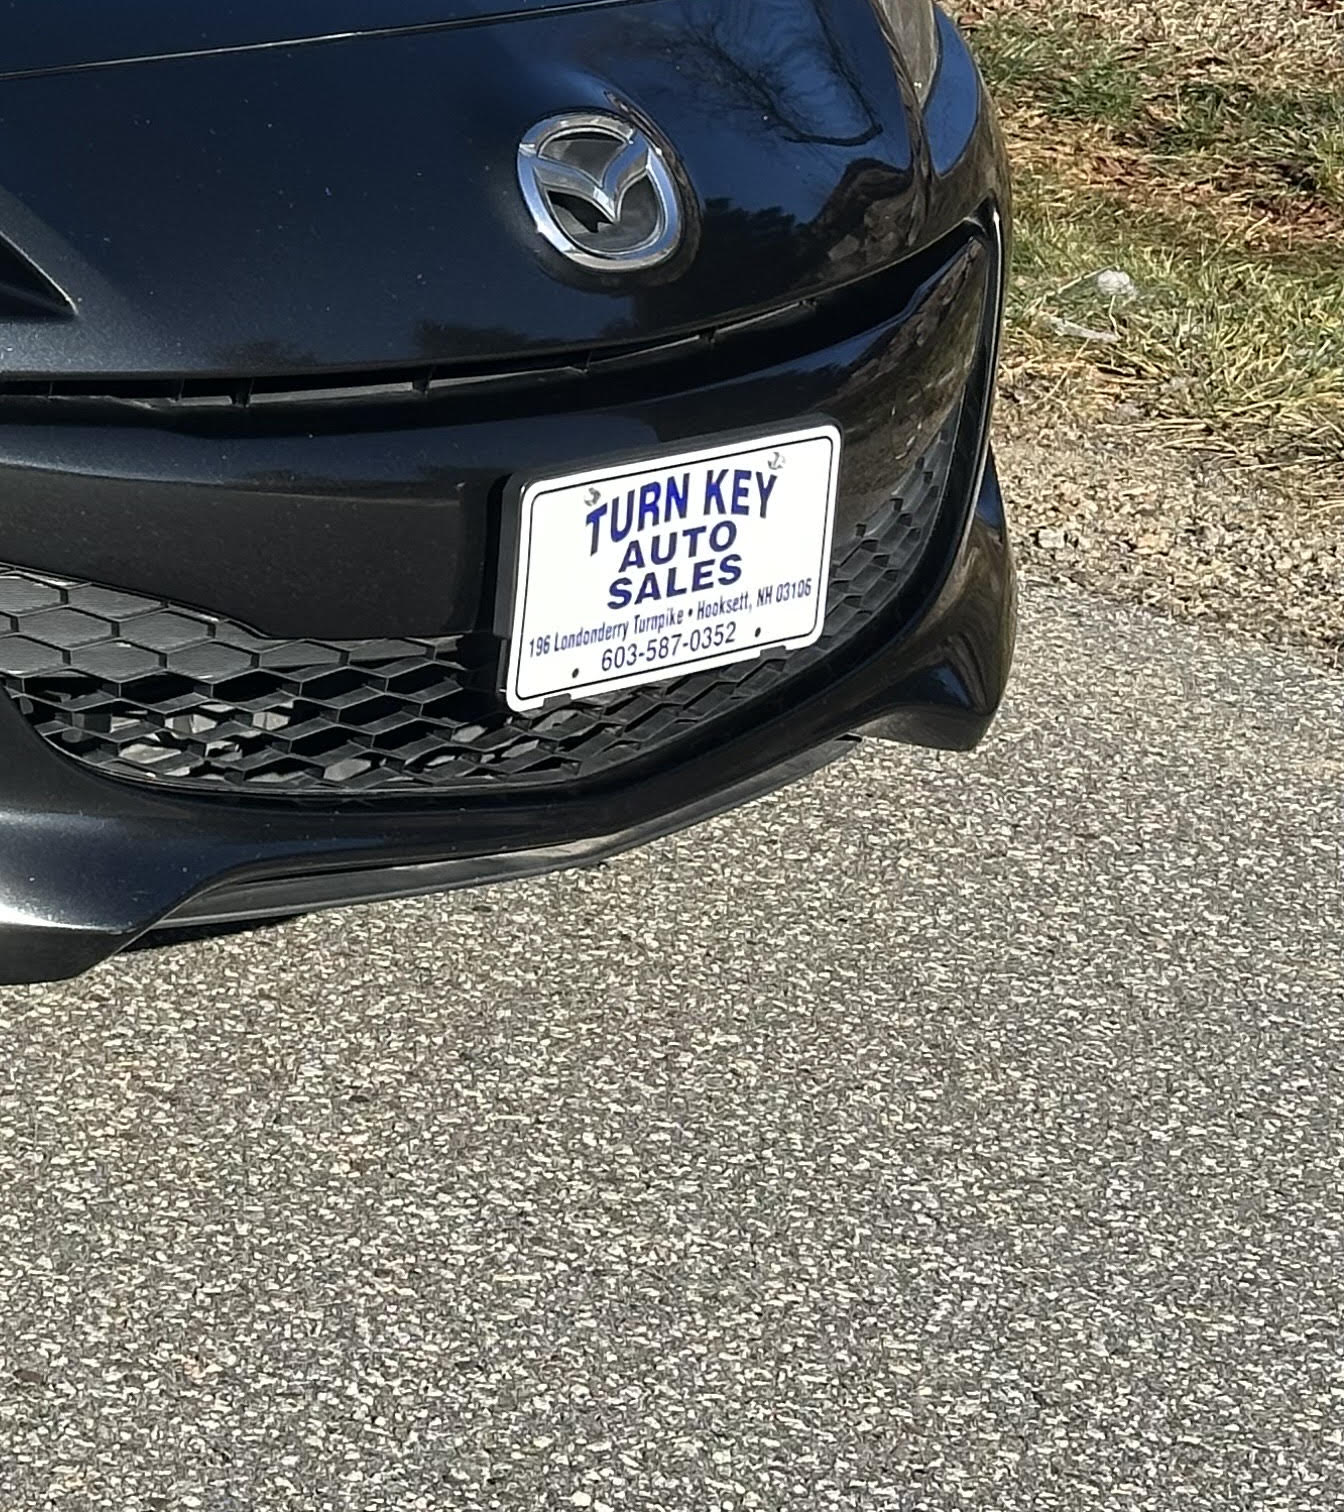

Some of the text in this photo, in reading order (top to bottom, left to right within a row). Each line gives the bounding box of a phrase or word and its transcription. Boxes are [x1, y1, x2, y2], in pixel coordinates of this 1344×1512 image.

[585, 469, 778, 556] TURN KEY
[618, 520, 737, 573] AUTO
[607, 554, 742, 609] SALES
[529, 577, 812, 658] 196 Londonderry Turnpike Hooksett, NH 03106
[601, 621, 737, 672] 603-587-0352
